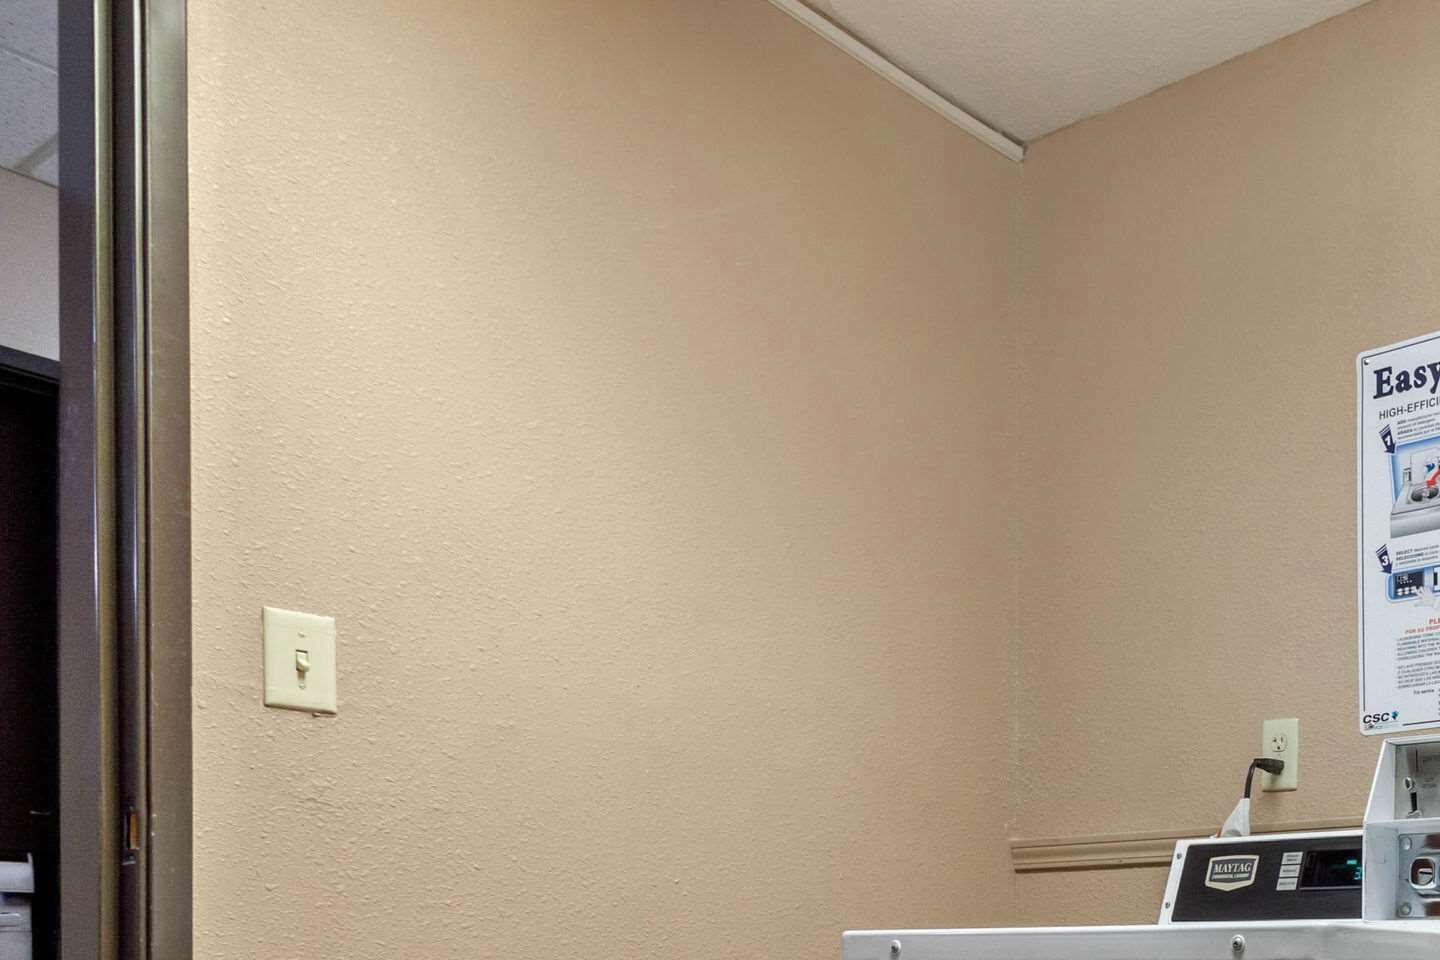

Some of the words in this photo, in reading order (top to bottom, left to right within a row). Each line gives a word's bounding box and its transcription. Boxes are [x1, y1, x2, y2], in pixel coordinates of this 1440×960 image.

[1384, 430, 1392, 445] 1
[1381, 555, 1389, 566] 3
[1363, 712, 1390, 724] CSC
[1214, 862, 1252, 873] MAYTAG
